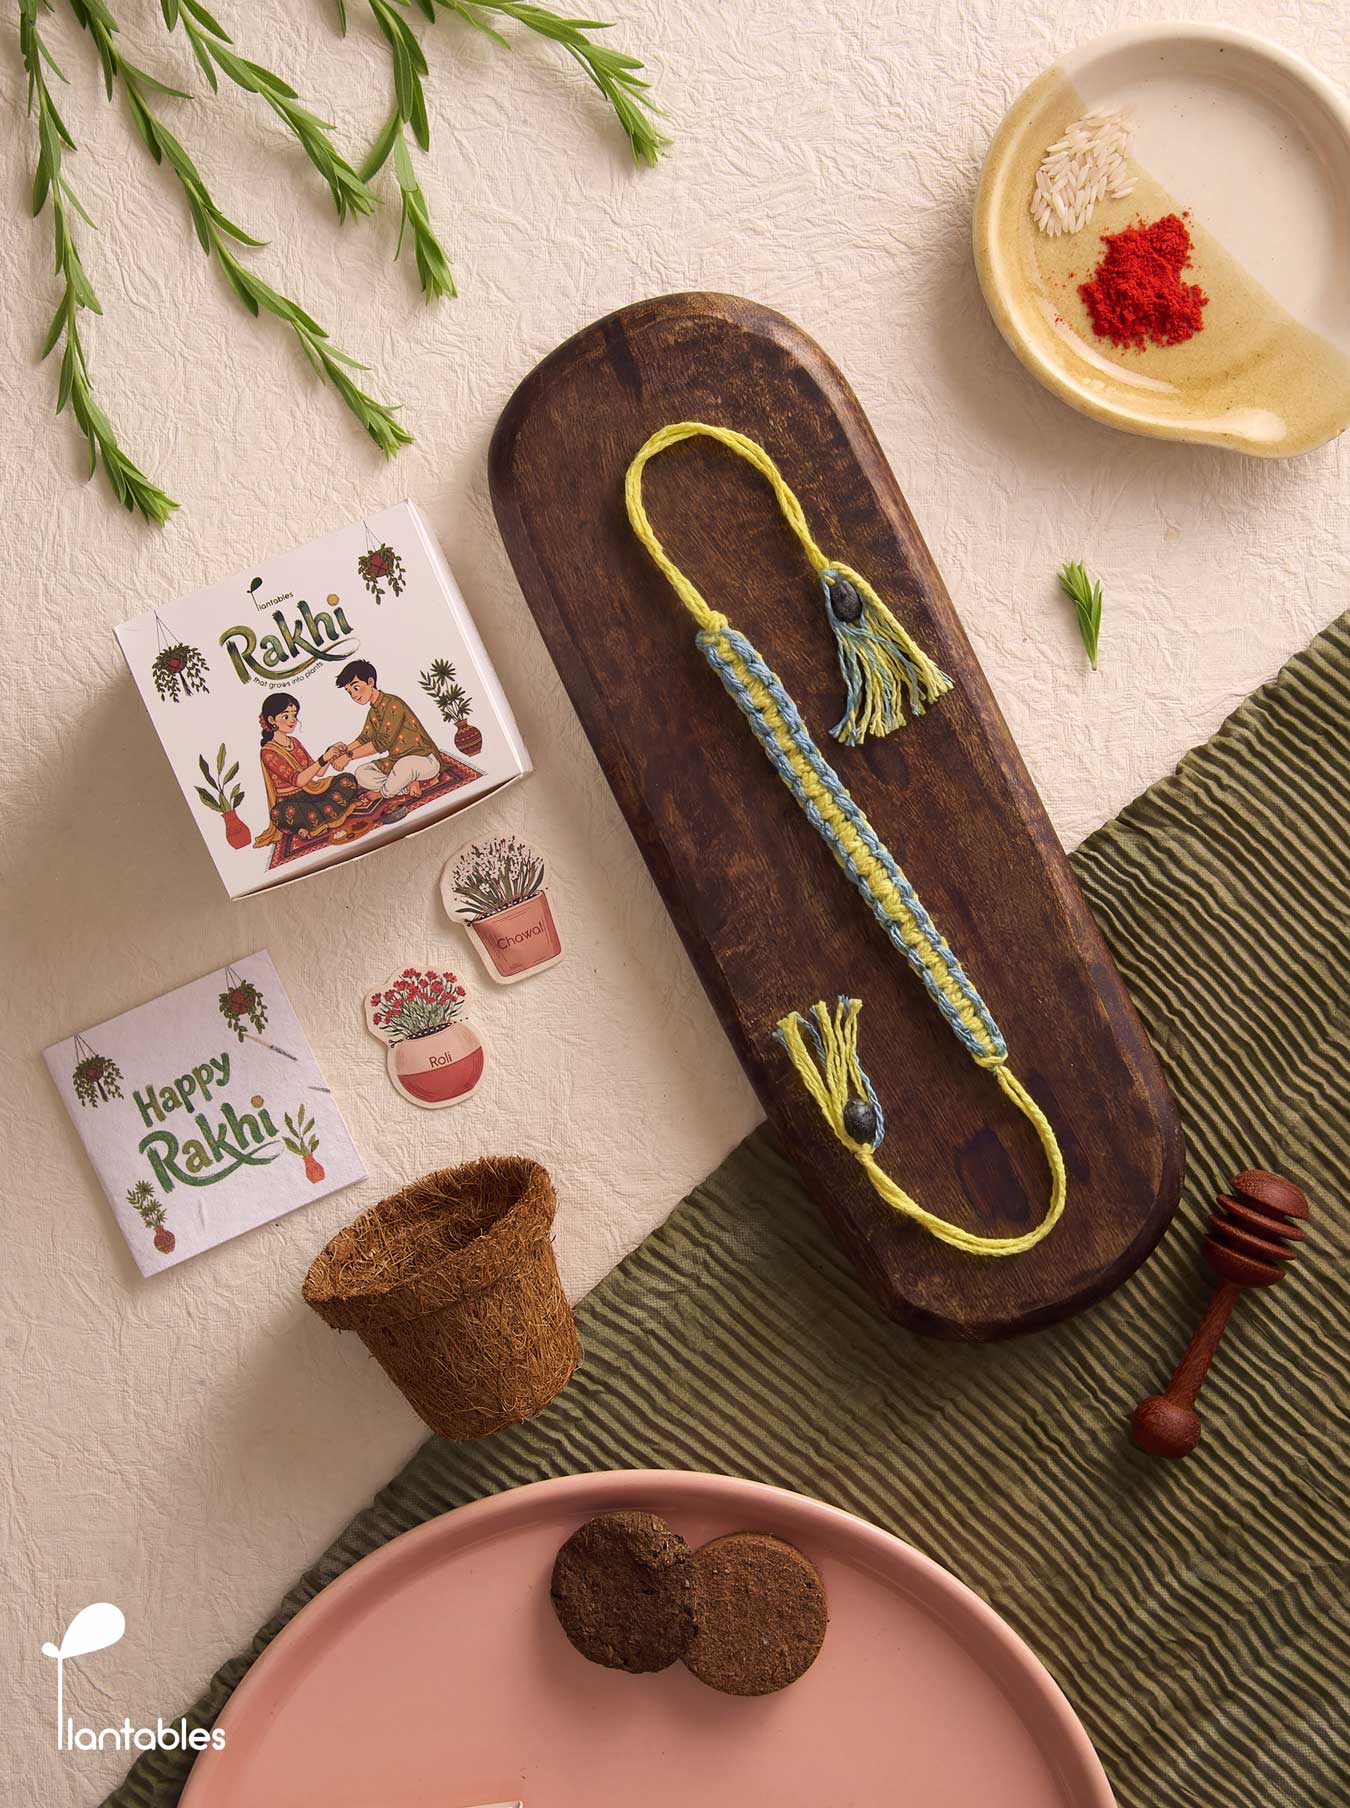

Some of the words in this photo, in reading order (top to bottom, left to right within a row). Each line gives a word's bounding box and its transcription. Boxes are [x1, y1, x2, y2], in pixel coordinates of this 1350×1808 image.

[219, 593, 360, 685] Rakhi
[253, 677, 267, 687] that
[268, 680, 291, 690] grows
[291, 675, 305, 684] into
[305, 661, 324, 679] plants
[497, 922, 545, 950] Chawal
[429, 1052, 453, 1068] Roli
[133, 1052, 231, 1128] Happy
[138, 1094, 281, 1194] Rakhi
